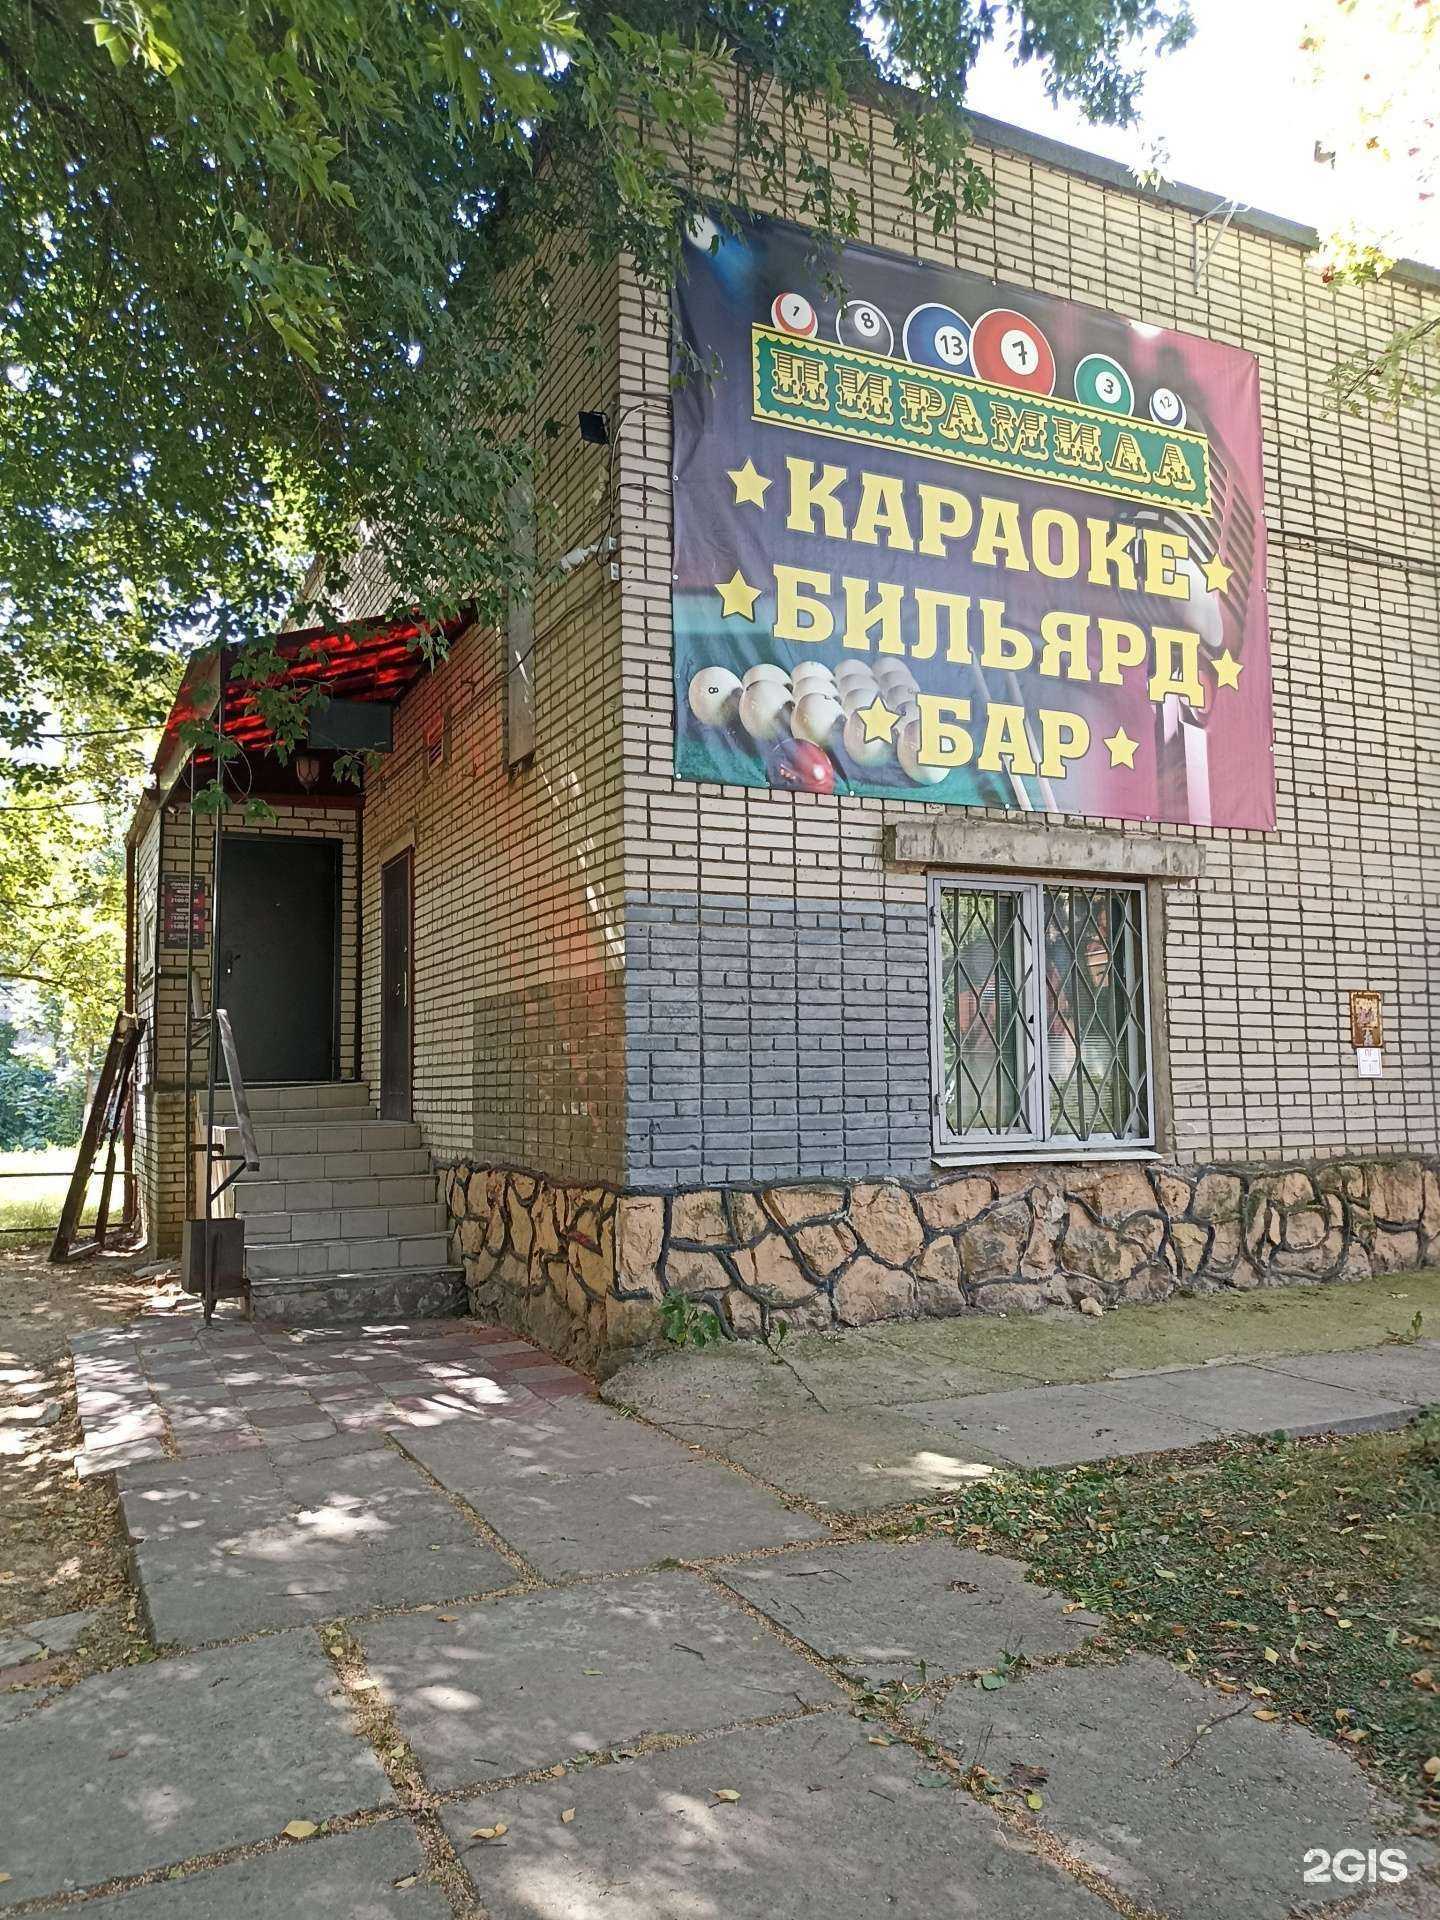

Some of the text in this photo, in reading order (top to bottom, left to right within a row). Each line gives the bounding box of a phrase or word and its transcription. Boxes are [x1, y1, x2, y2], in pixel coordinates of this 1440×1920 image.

[860, 312, 875, 330] 8
[940, 334, 964, 356] 13
[1012, 340, 1028, 366] 7
[1103, 378, 1114, 395] 3
[1159, 396, 1173, 409] 12
[770, 348, 1197, 492] ПИРАМИДА
[785, 455, 1191, 601] КАРАОКЕ
[772, 563, 1205, 709] БИЛЬЯРД
[916, 693, 1091, 779] БАР
